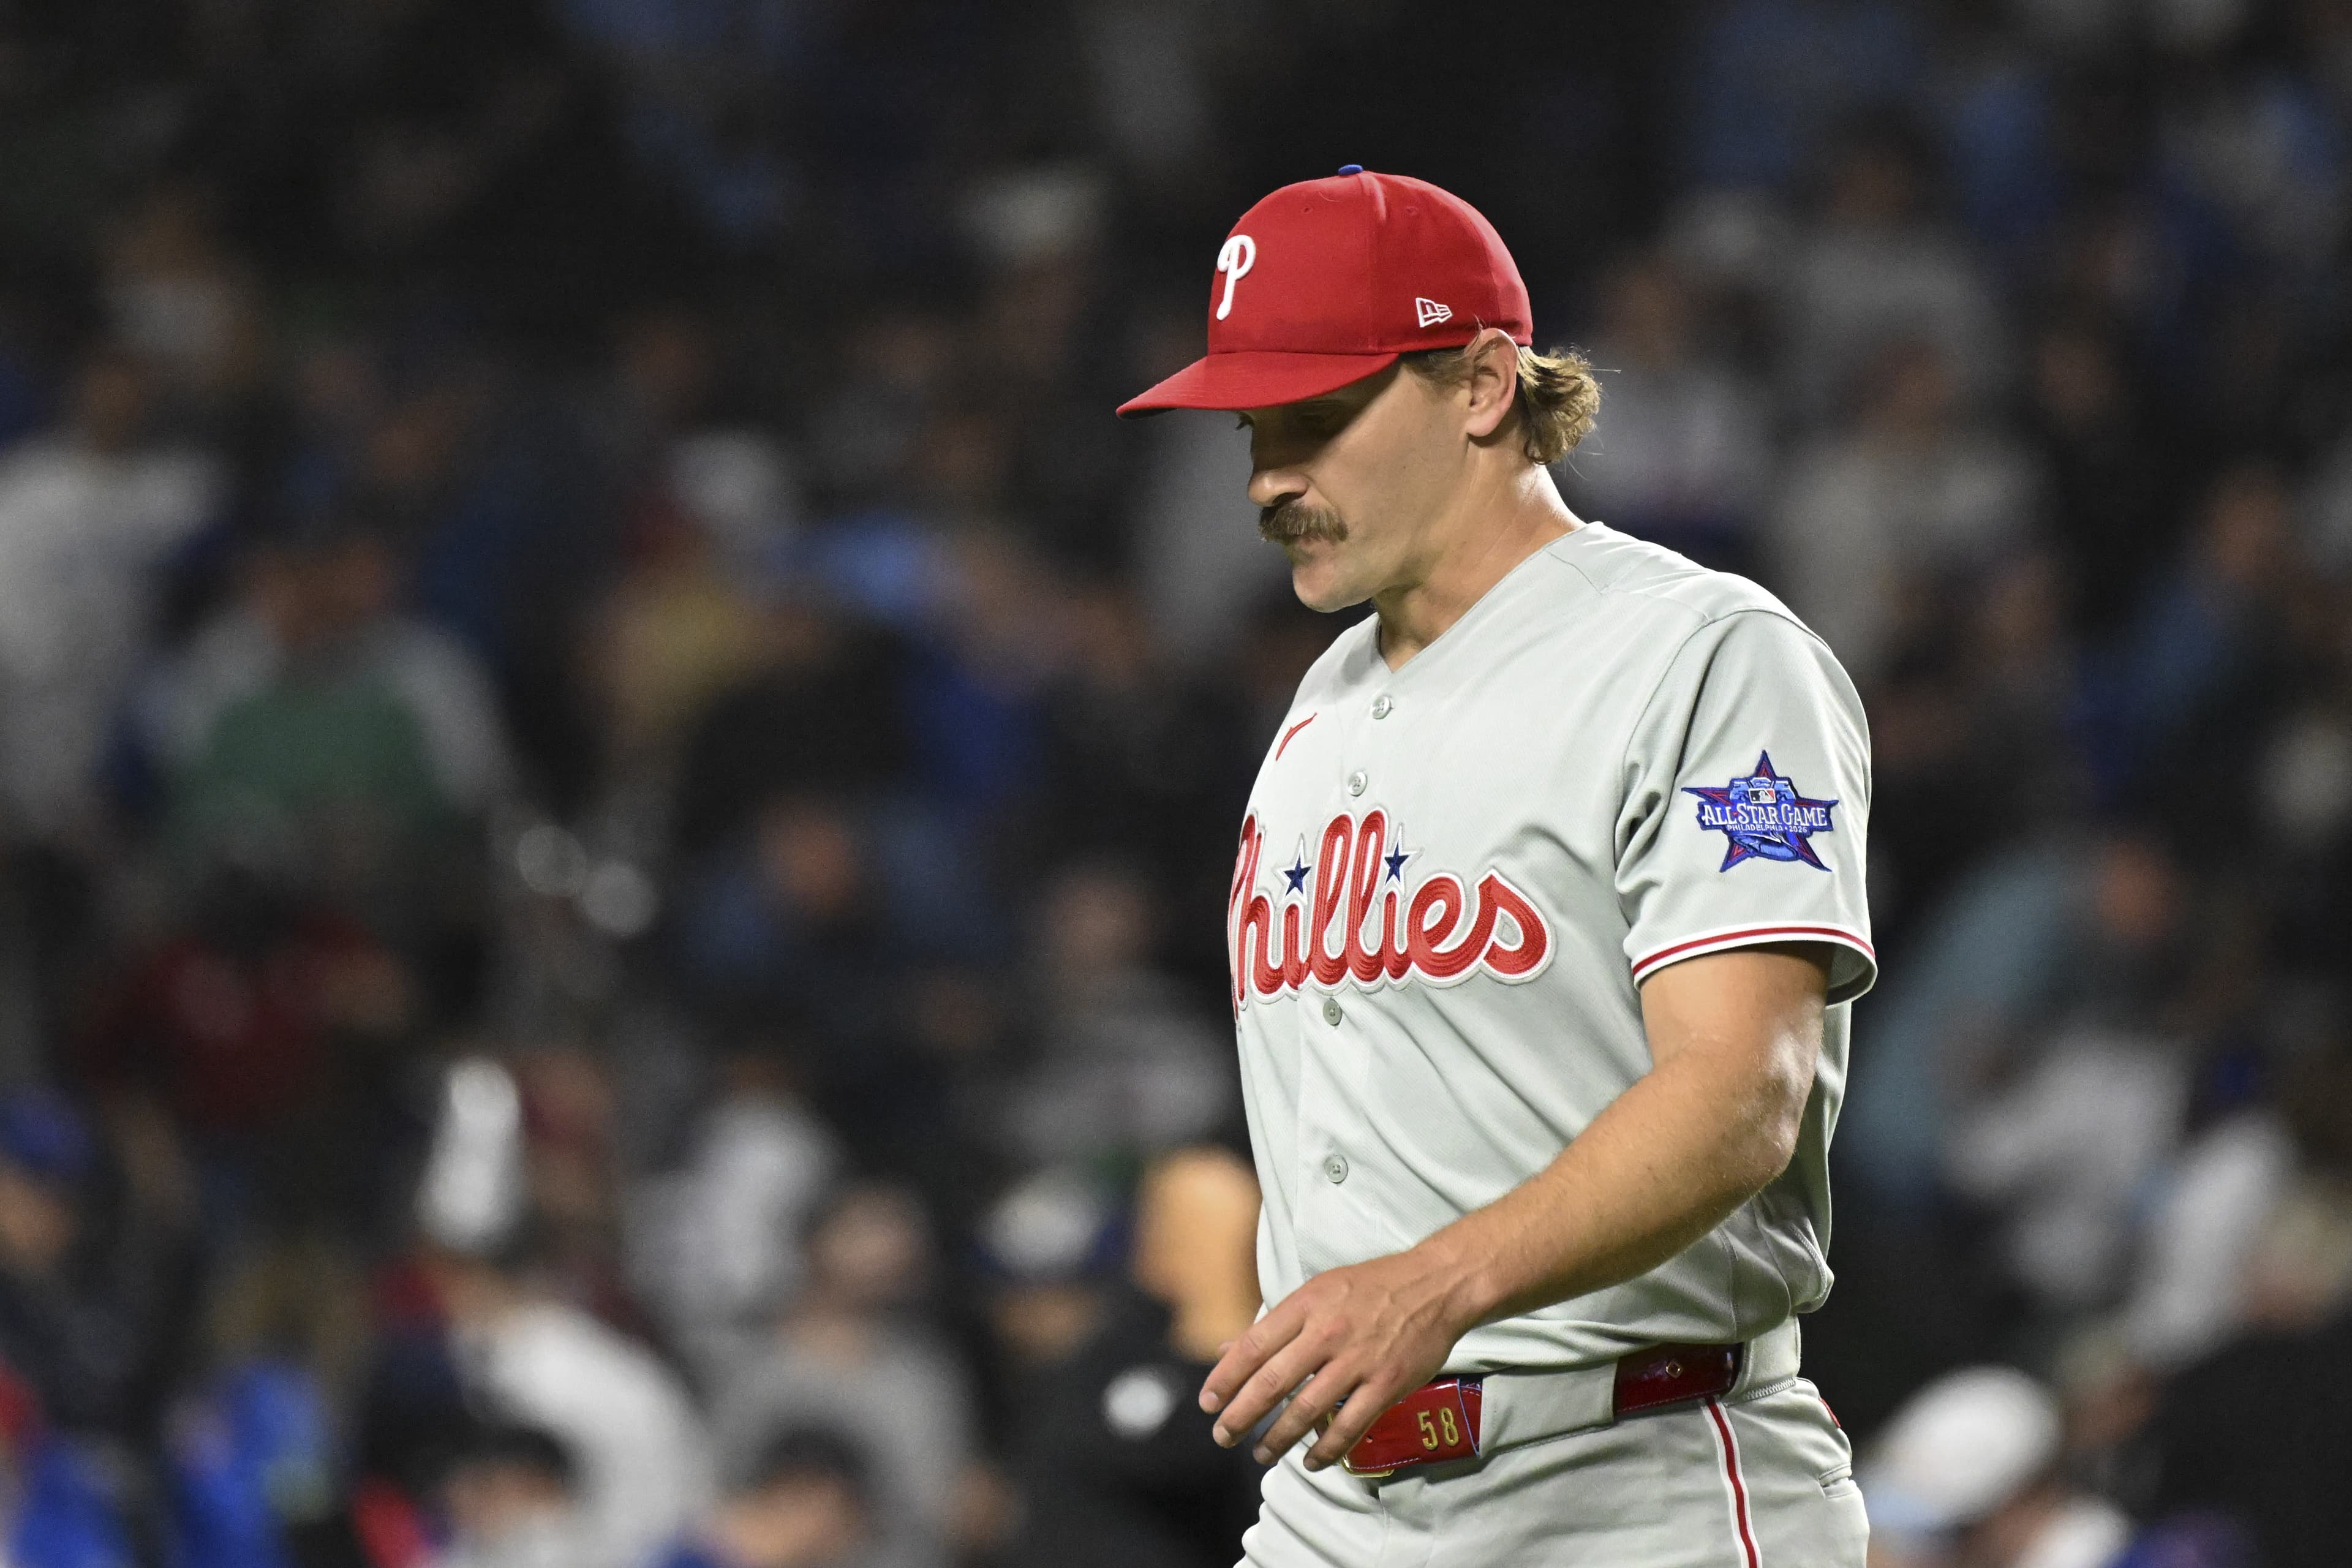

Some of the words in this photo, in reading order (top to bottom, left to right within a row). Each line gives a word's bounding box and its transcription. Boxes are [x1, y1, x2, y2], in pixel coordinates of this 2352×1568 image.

[1216, 234, 1257, 322] P
[1781, 803, 1828, 826] GAME
[1417, 1408, 1459, 1450] 58
